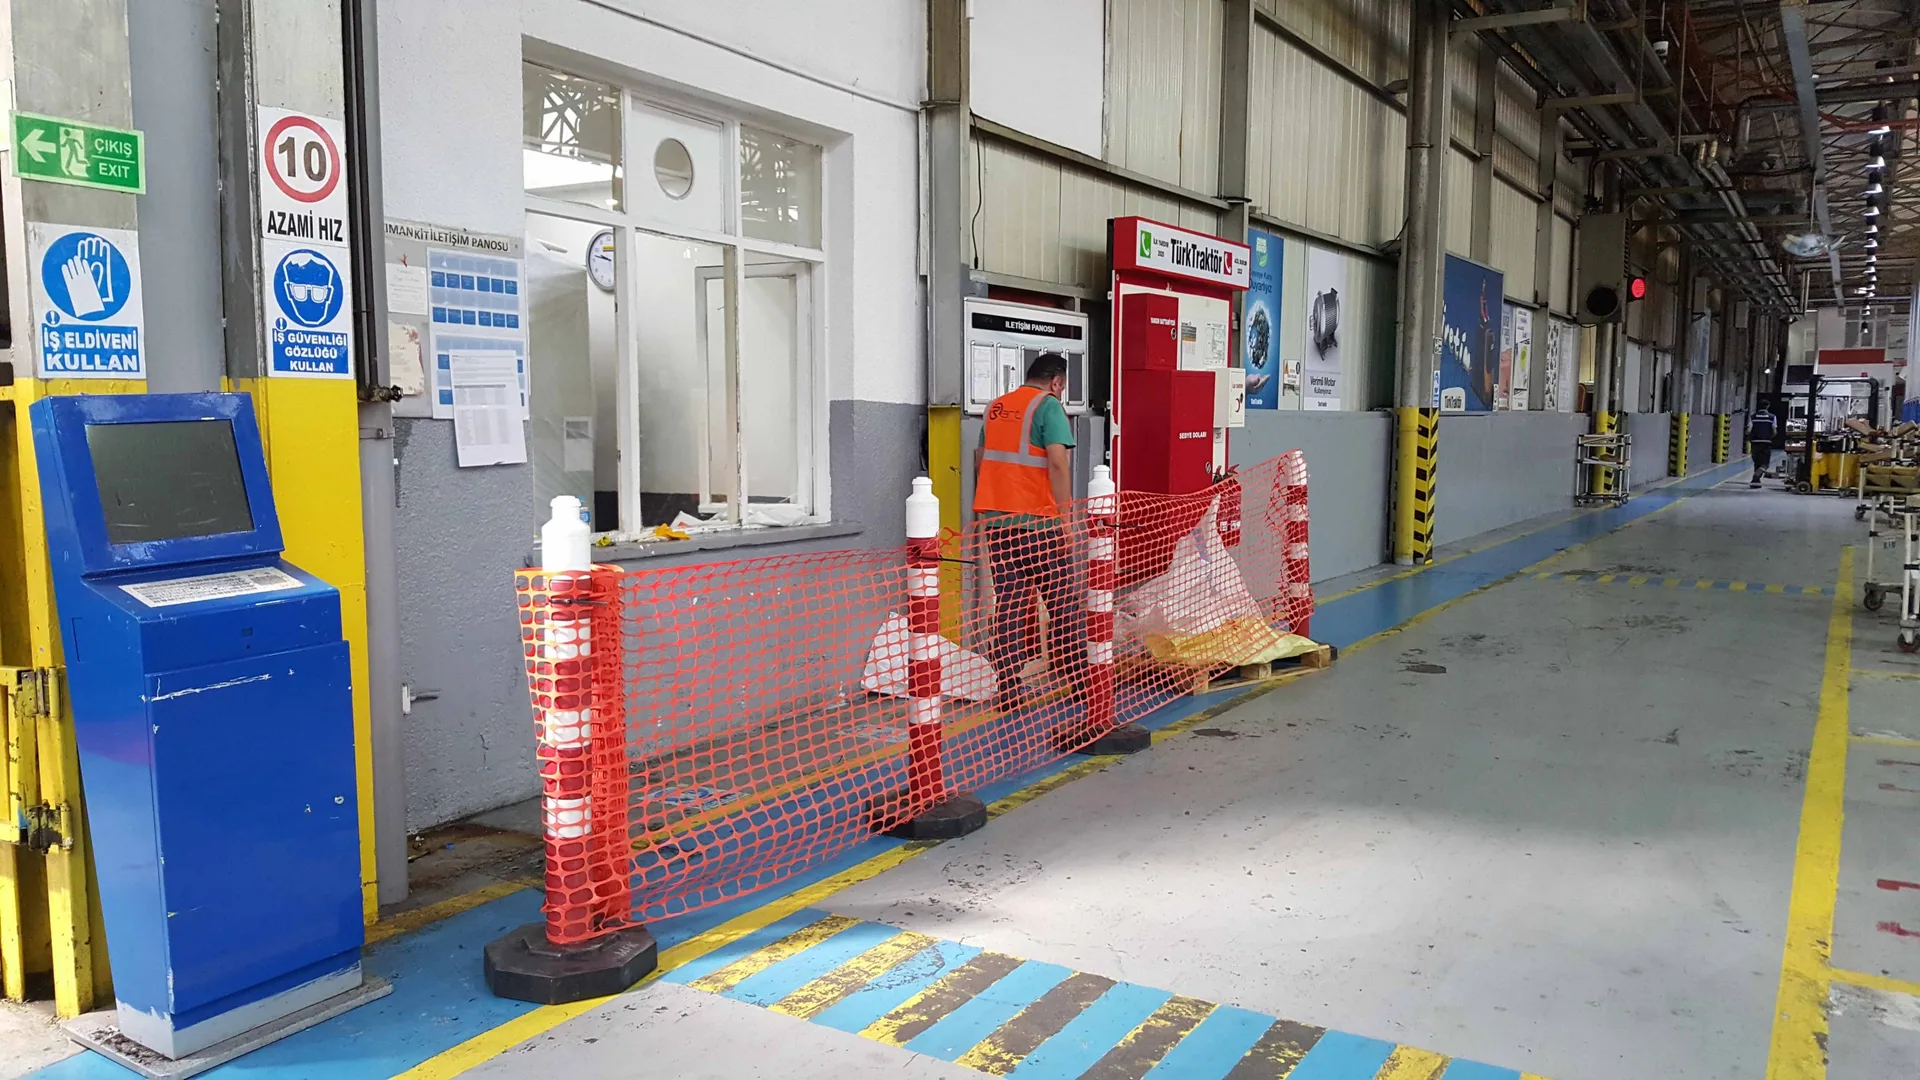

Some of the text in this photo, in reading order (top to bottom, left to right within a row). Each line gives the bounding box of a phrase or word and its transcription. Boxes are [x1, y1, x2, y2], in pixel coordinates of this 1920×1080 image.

[94, 138, 133, 158] ÇIKIŞ
[279, 136, 327, 182] 10
[99, 162, 130, 179] EXIT
[267, 209, 343, 242] AZAMİ HIZ
[471, 237, 509, 252] PANOSU
[1170, 238, 1222, 274] TürkTraktör
[1032, 323, 1056, 333] PANOSU
[44, 327, 136, 352] İŞ ELDİVENİ
[274, 330, 347, 346] İŞ GÜVENLİĞİ
[284, 345, 338, 359] GÖZLÜĞÜ
[46, 353, 138, 371] KULLAN
[290, 360, 334, 372] KULLAN
